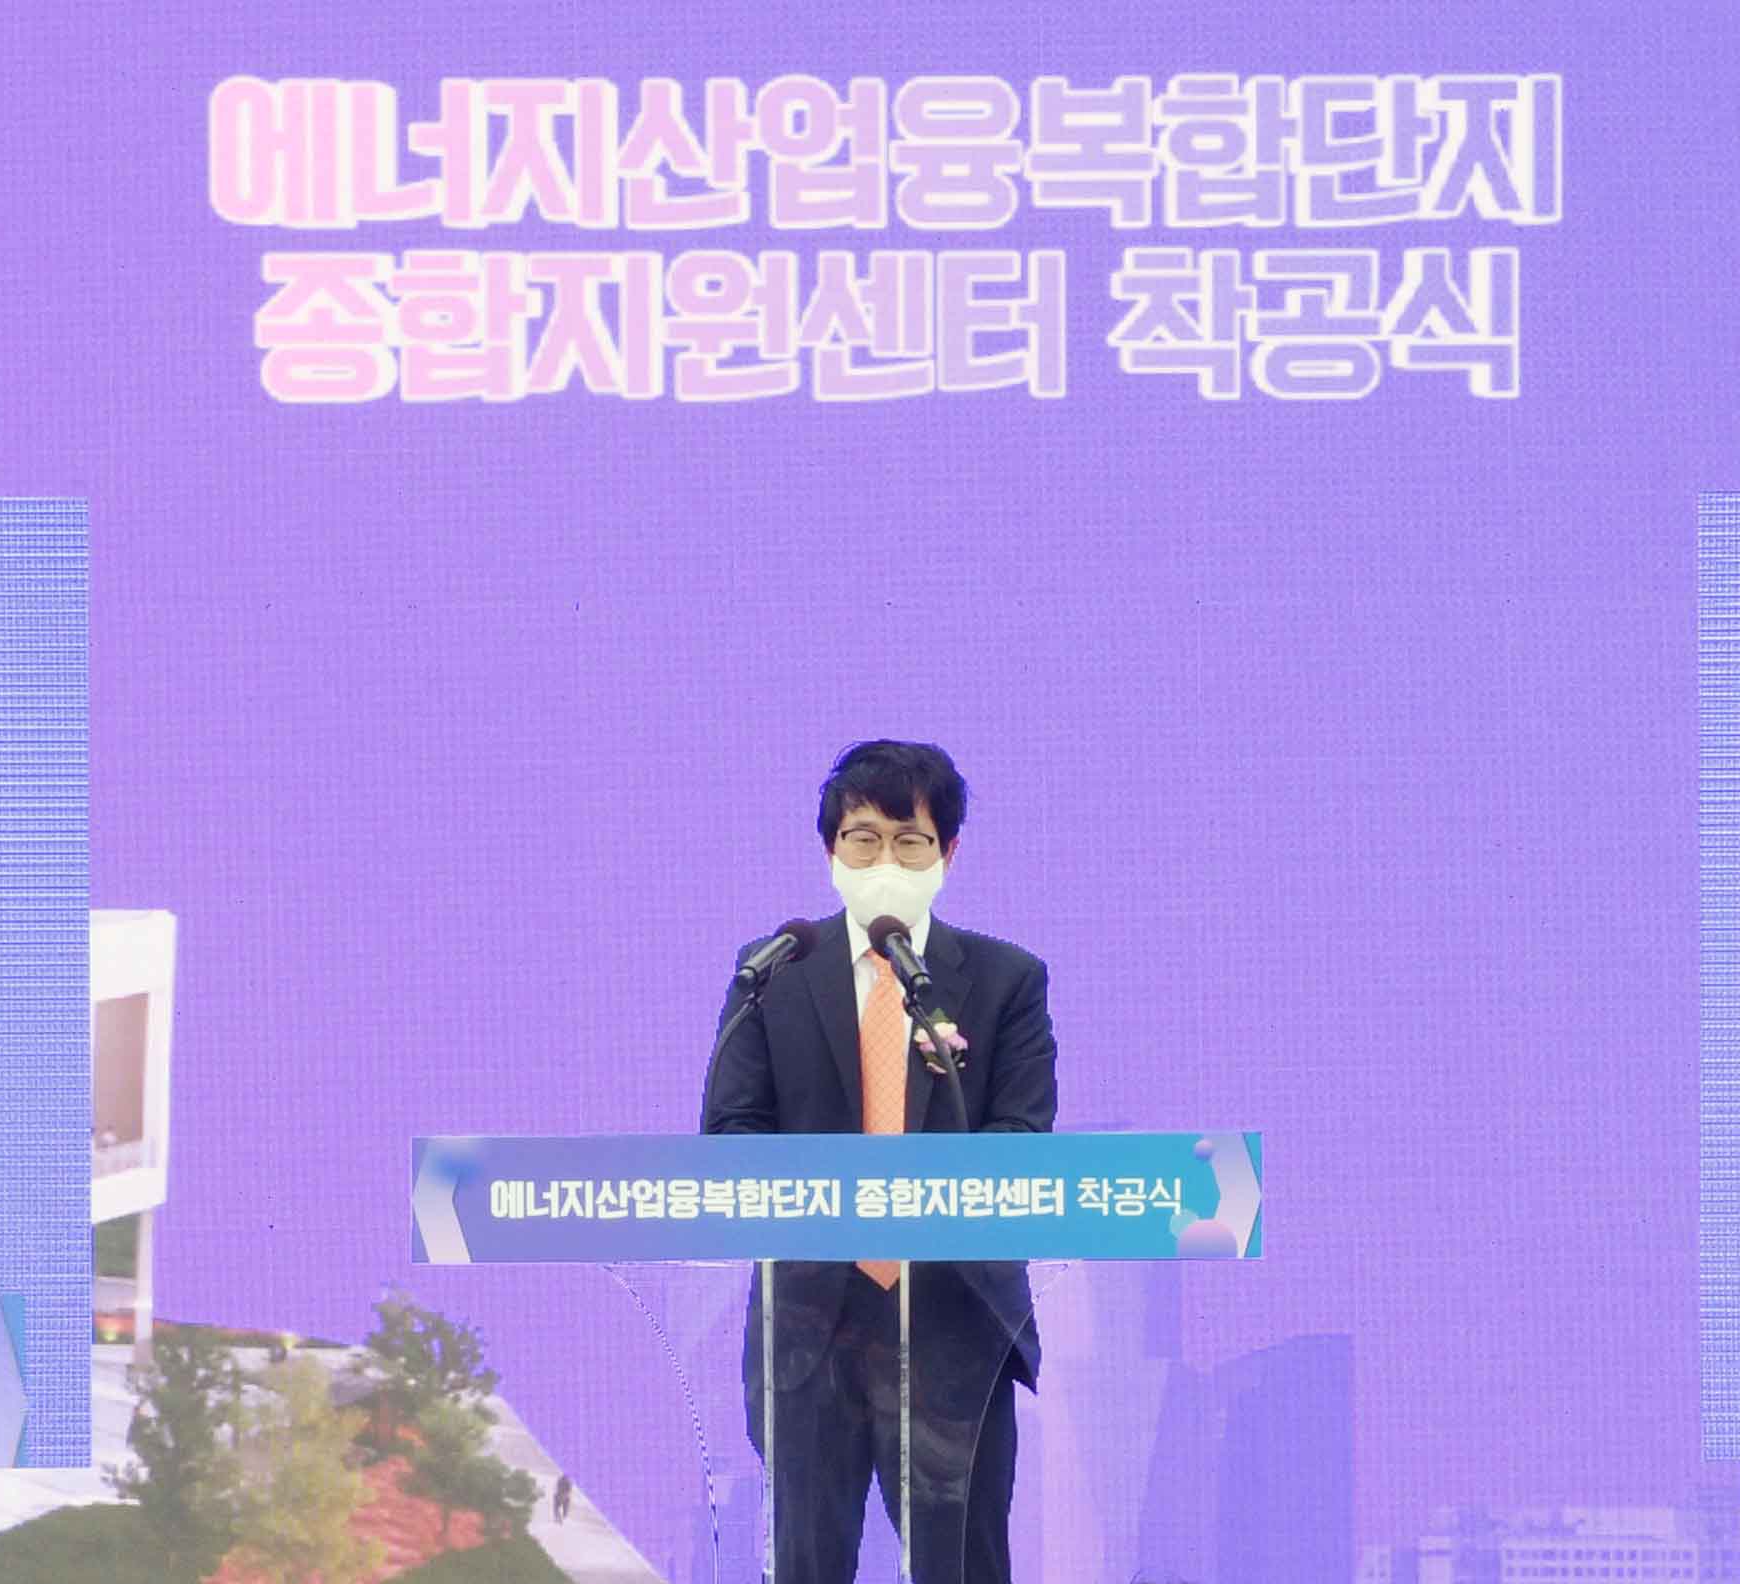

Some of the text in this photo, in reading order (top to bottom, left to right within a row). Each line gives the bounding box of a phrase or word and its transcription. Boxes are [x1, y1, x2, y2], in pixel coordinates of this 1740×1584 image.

[209, 73, 1563, 230] 에너지산업융복합단지
[255, 247, 1520, 403] 종합지원센터 착공식
[490, 1177, 1182, 1219] 에너지산업융복합단지 종합지원센터 착공식
